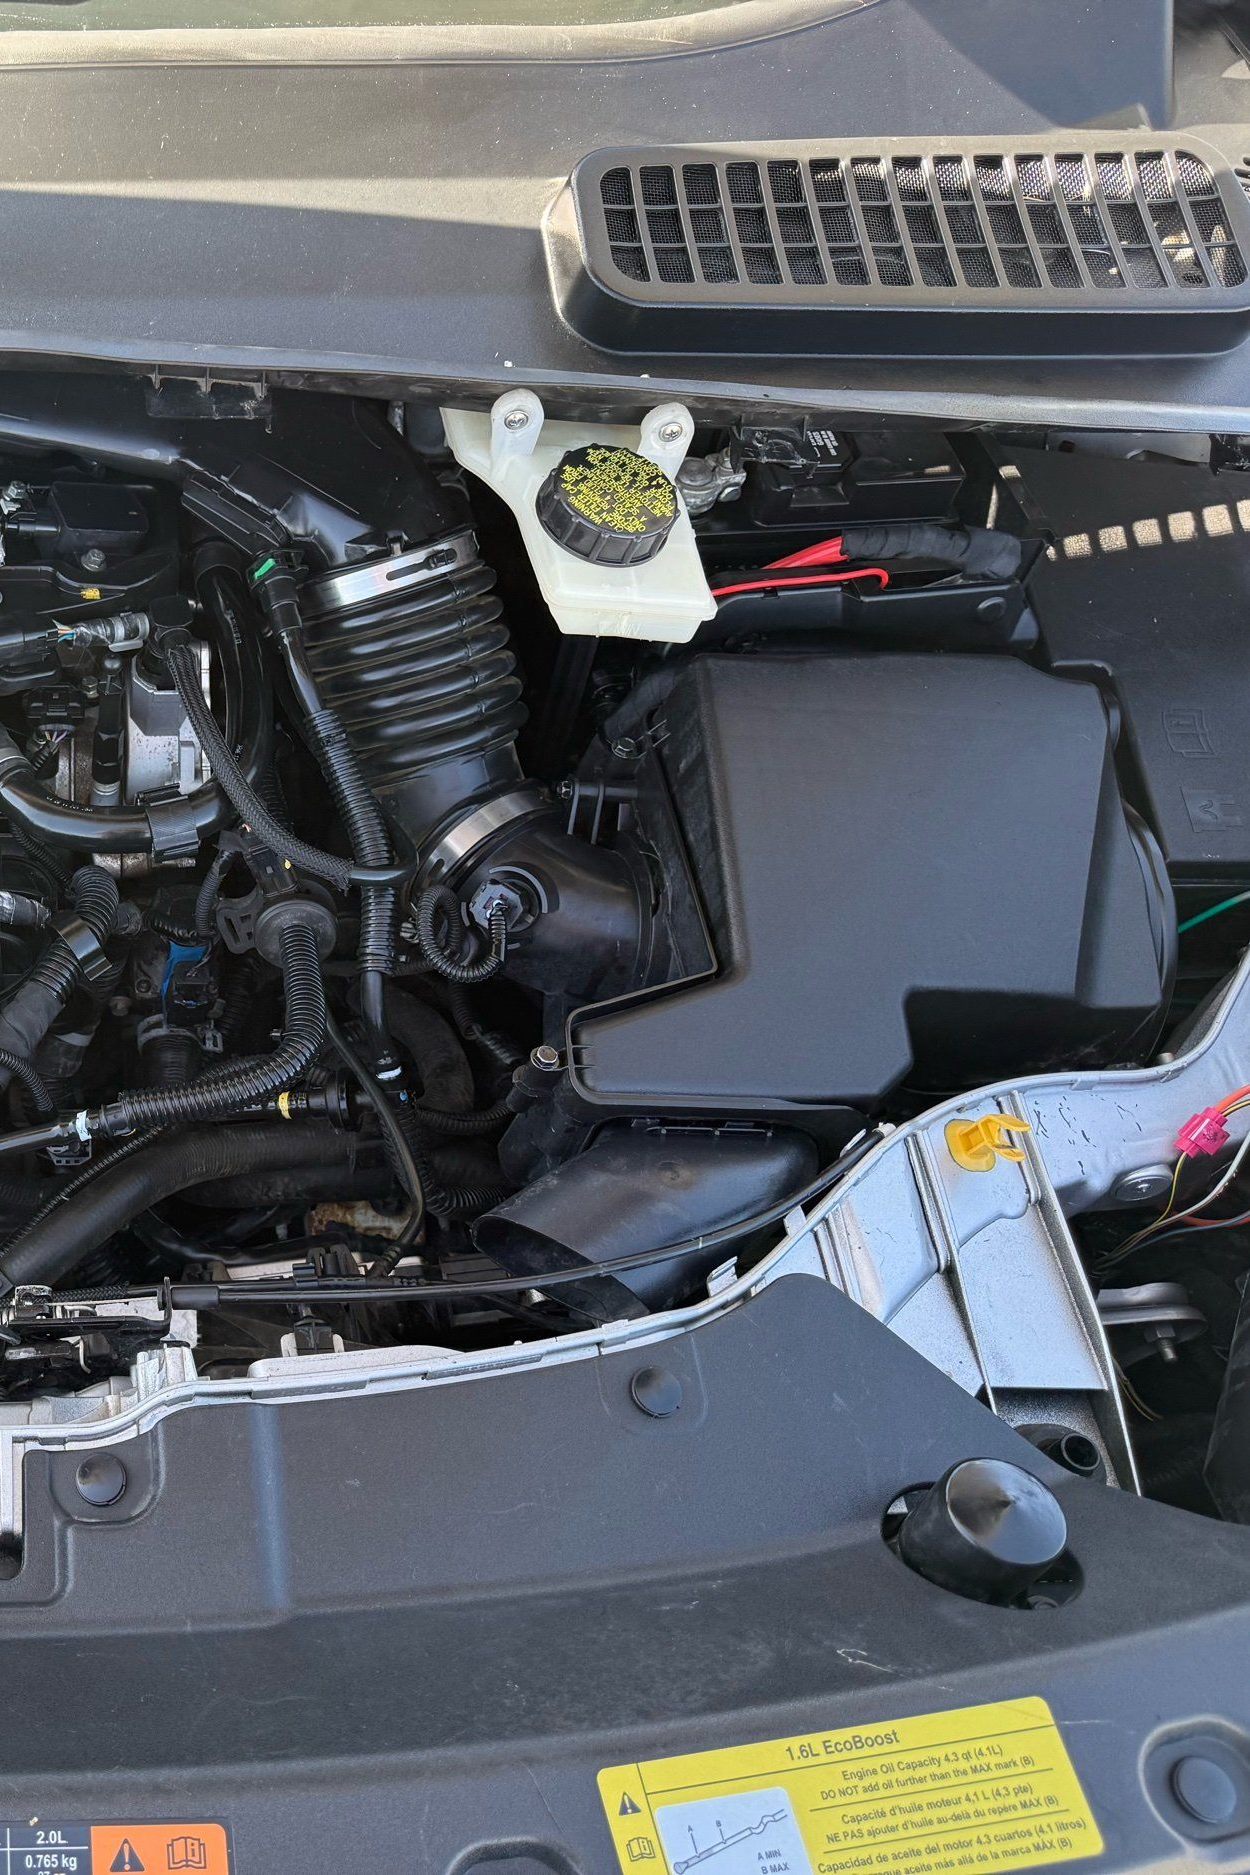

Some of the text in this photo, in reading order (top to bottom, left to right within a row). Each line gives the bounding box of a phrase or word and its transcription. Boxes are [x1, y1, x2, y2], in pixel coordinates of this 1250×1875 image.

[560, 470, 576, 484] USE
[563, 465, 585, 480] FROM
[623, 464, 634, 474] DU
[583, 477, 604, 496] FLUID
[586, 453, 664, 517] NETTOYER LE BOUCHON
[632, 480, 644, 490] LE
[634, 474, 649, 486] QUE
[575, 492, 601, 512] FILLER
[614, 491, 641, 515] SEALED
[642, 490, 654, 499] DE
[650, 487, 675, 510] PLOYER
[658, 487, 673, 500] DOT
[612, 500, 629, 516] DOT
[652, 497, 674, 518] AVANT
[600, 512, 624, 532] CLEAN
[609, 509, 636, 533] BEFORE
[625, 515, 646, 532] ONLY
[639, 515, 648, 524] A
[786, 1730, 900, 1760] 1.6L EcoBoost
[842, 1768, 878, 1780] Engine
[880, 1763, 895, 1774] Oil
[897, 1756, 940, 1771] Capacity
[944, 1752, 959, 1762] 4.3
[820, 1756, 1034, 1800] DO NOT add oil further than the MAX mark (B)
[826, 1833, 841, 1843] NE
[843, 1829, 864, 1840] PAS
[867, 1824, 899, 1838] ajouter
[902, 1818, 934, 1830] d'huile
[973, 1809, 986, 1818] du
[1020, 1798, 1042, 1809] MAX
[1044, 1795, 1058, 1807] (B)
[842, 1808, 886, 1824] Capacité
[890, 1803, 923, 1816] d'huile
[926, 1797, 961, 1810] moteur
[36, 1831, 67, 1844] 2.0L
[818, 1855, 873, 1874] Capacidad
[876, 1853, 888, 1863] de
[892, 1848, 922, 1860] aceite
[925, 1843, 940, 1854] del
[943, 1840, 972, 1851] motor
[976, 1834, 991, 1845] 4.3
[994, 1830, 1032, 1842] cuartos
[1055, 1818, 1086, 1831] litros)
[25, 1854, 77, 1871] 0.765 kg
[765, 1849, 781, 1859] MIN
[904, 1863, 932, 1874] aceite
[976, 1853, 988, 1862] de
[990, 1851, 1000, 1859] la
[1001, 1847, 1031, 1858] marca
[1058, 1838, 1072, 1850] (B)
[770, 1862, 790, 1872] MAX
